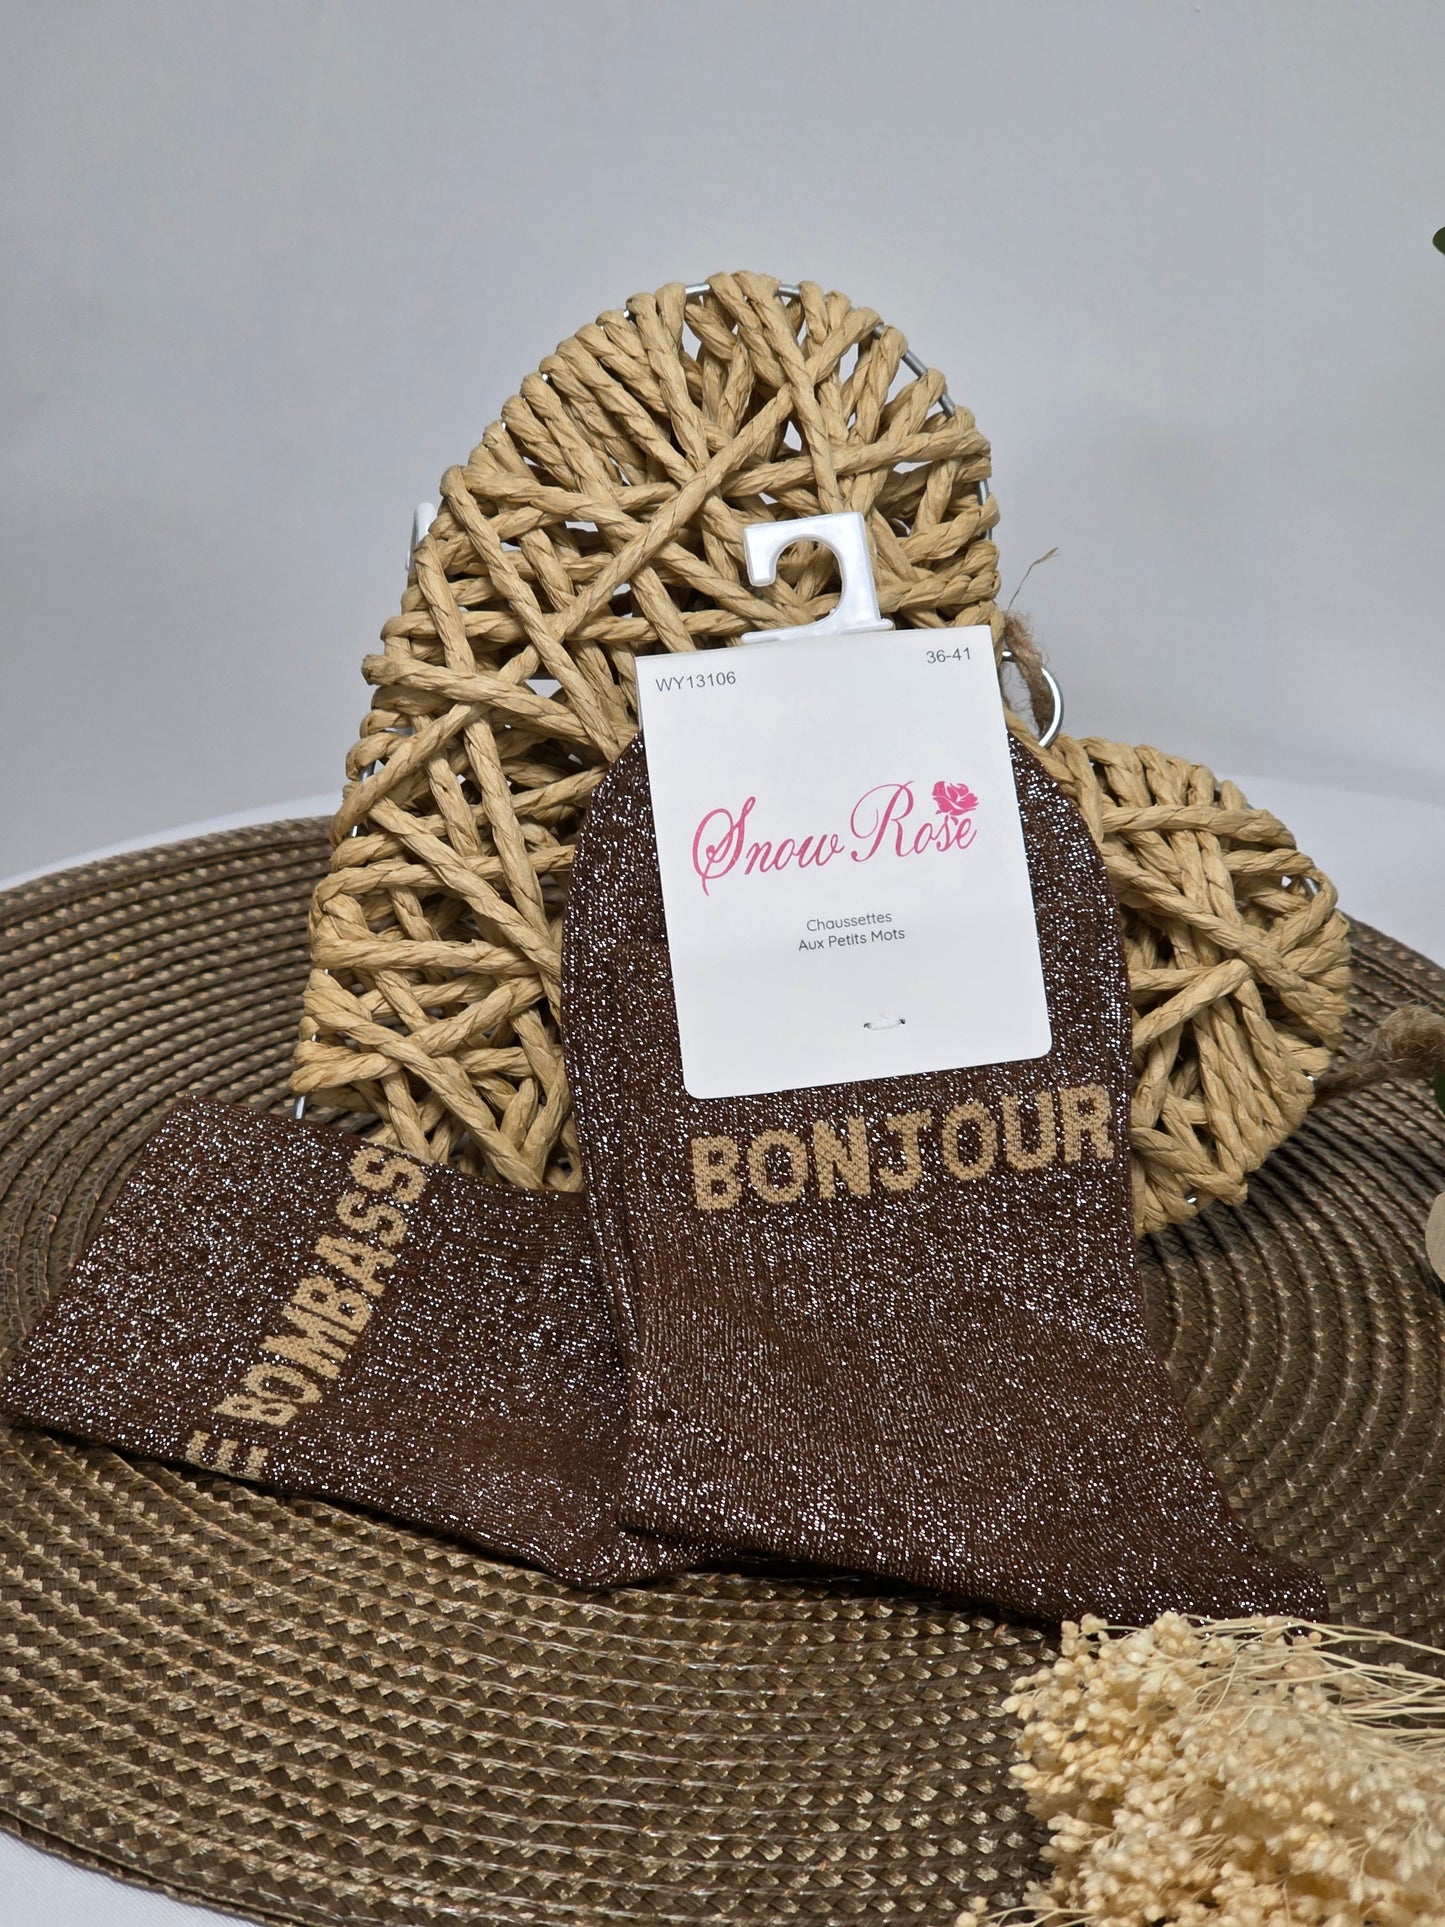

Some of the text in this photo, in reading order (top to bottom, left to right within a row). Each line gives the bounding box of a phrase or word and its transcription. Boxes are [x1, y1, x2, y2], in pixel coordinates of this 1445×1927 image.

[925, 647, 972, 664] 36-41
[655, 671, 737, 692] WY13106
[692, 781, 978, 896] Snow Rose
[806, 912, 893, 932] Chaussettes
[798, 928, 906, 952] Aux Petits Mots
[691, 1084, 1114, 1211] BONJOUR
[211, 1139, 434, 1426] BOMBASS
